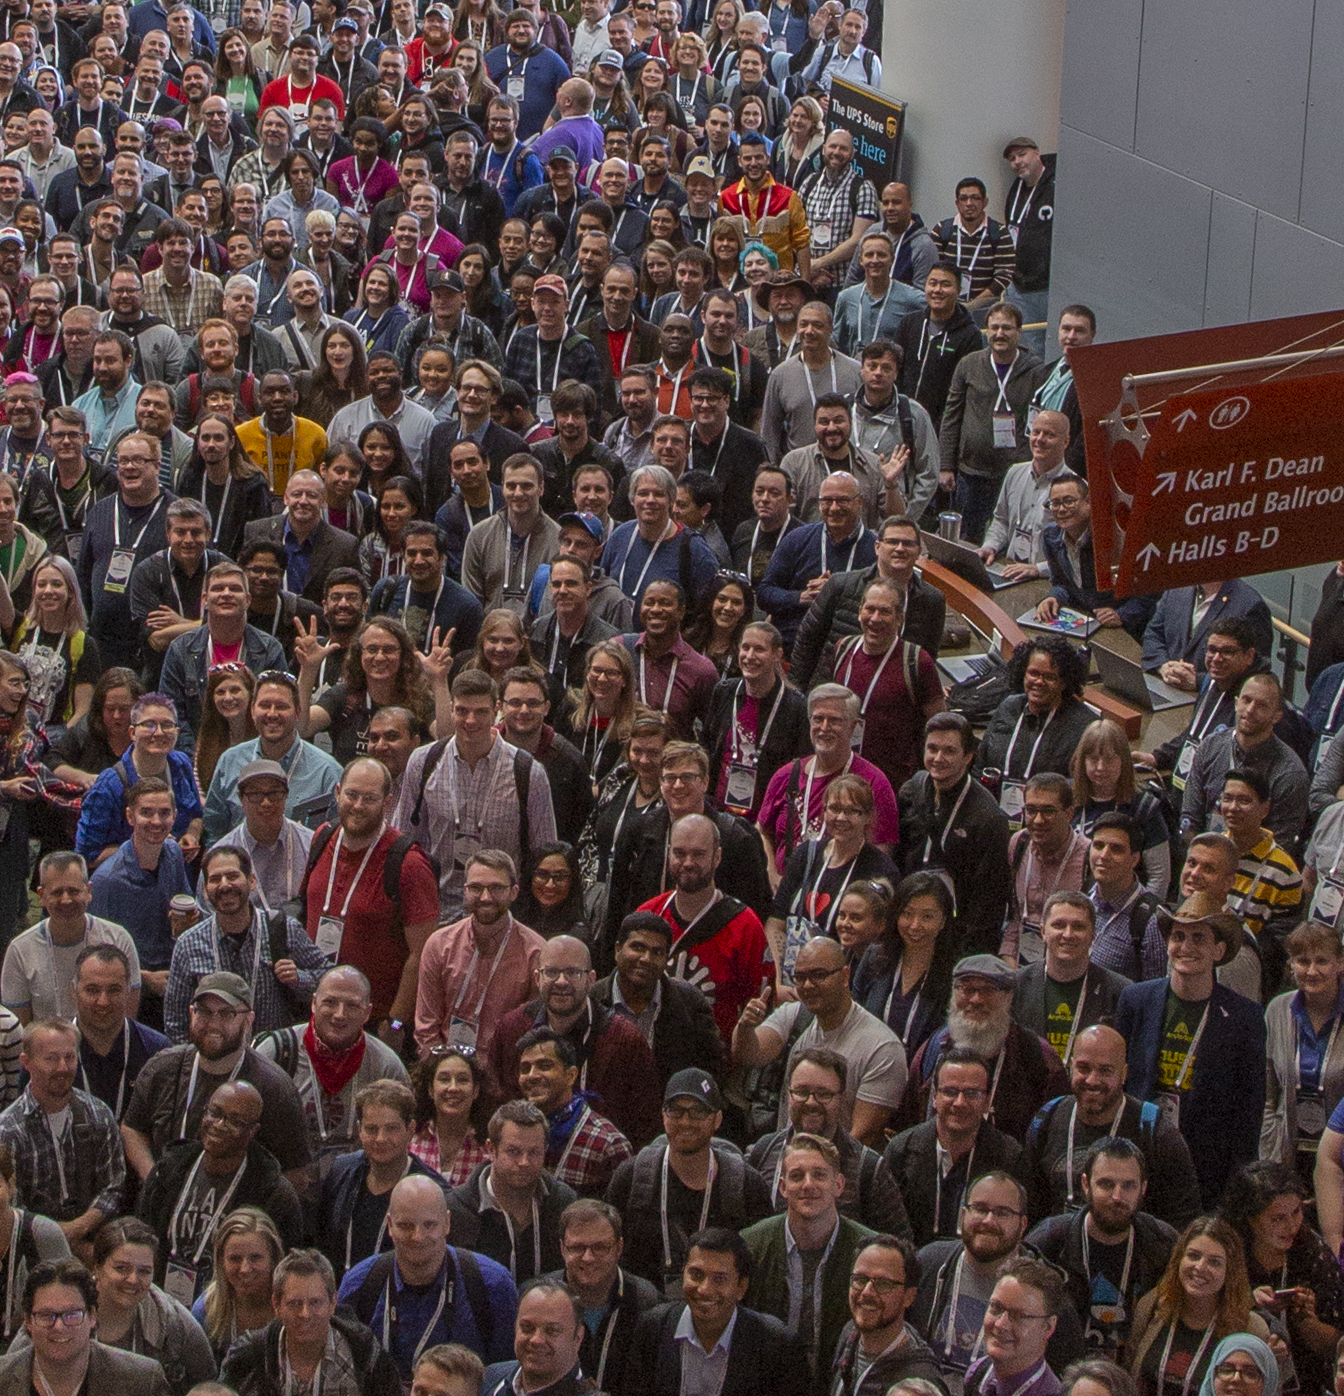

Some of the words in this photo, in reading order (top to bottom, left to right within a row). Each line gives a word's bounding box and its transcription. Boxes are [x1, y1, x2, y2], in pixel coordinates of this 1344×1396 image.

[832, 98, 846, 116] The
[846, 105, 863, 123] UPS
[863, 113, 884, 134] Store
[860, 134, 886, 164] here
[1184, 463, 1235, 493] Karl
[1239, 460, 1257, 483] F.
[1264, 455, 1325, 481] Dean
[1184, 494, 1258, 526] Grand
[1167, 535, 1228, 564] Halls
[1234, 526, 1280, 554] B-D
